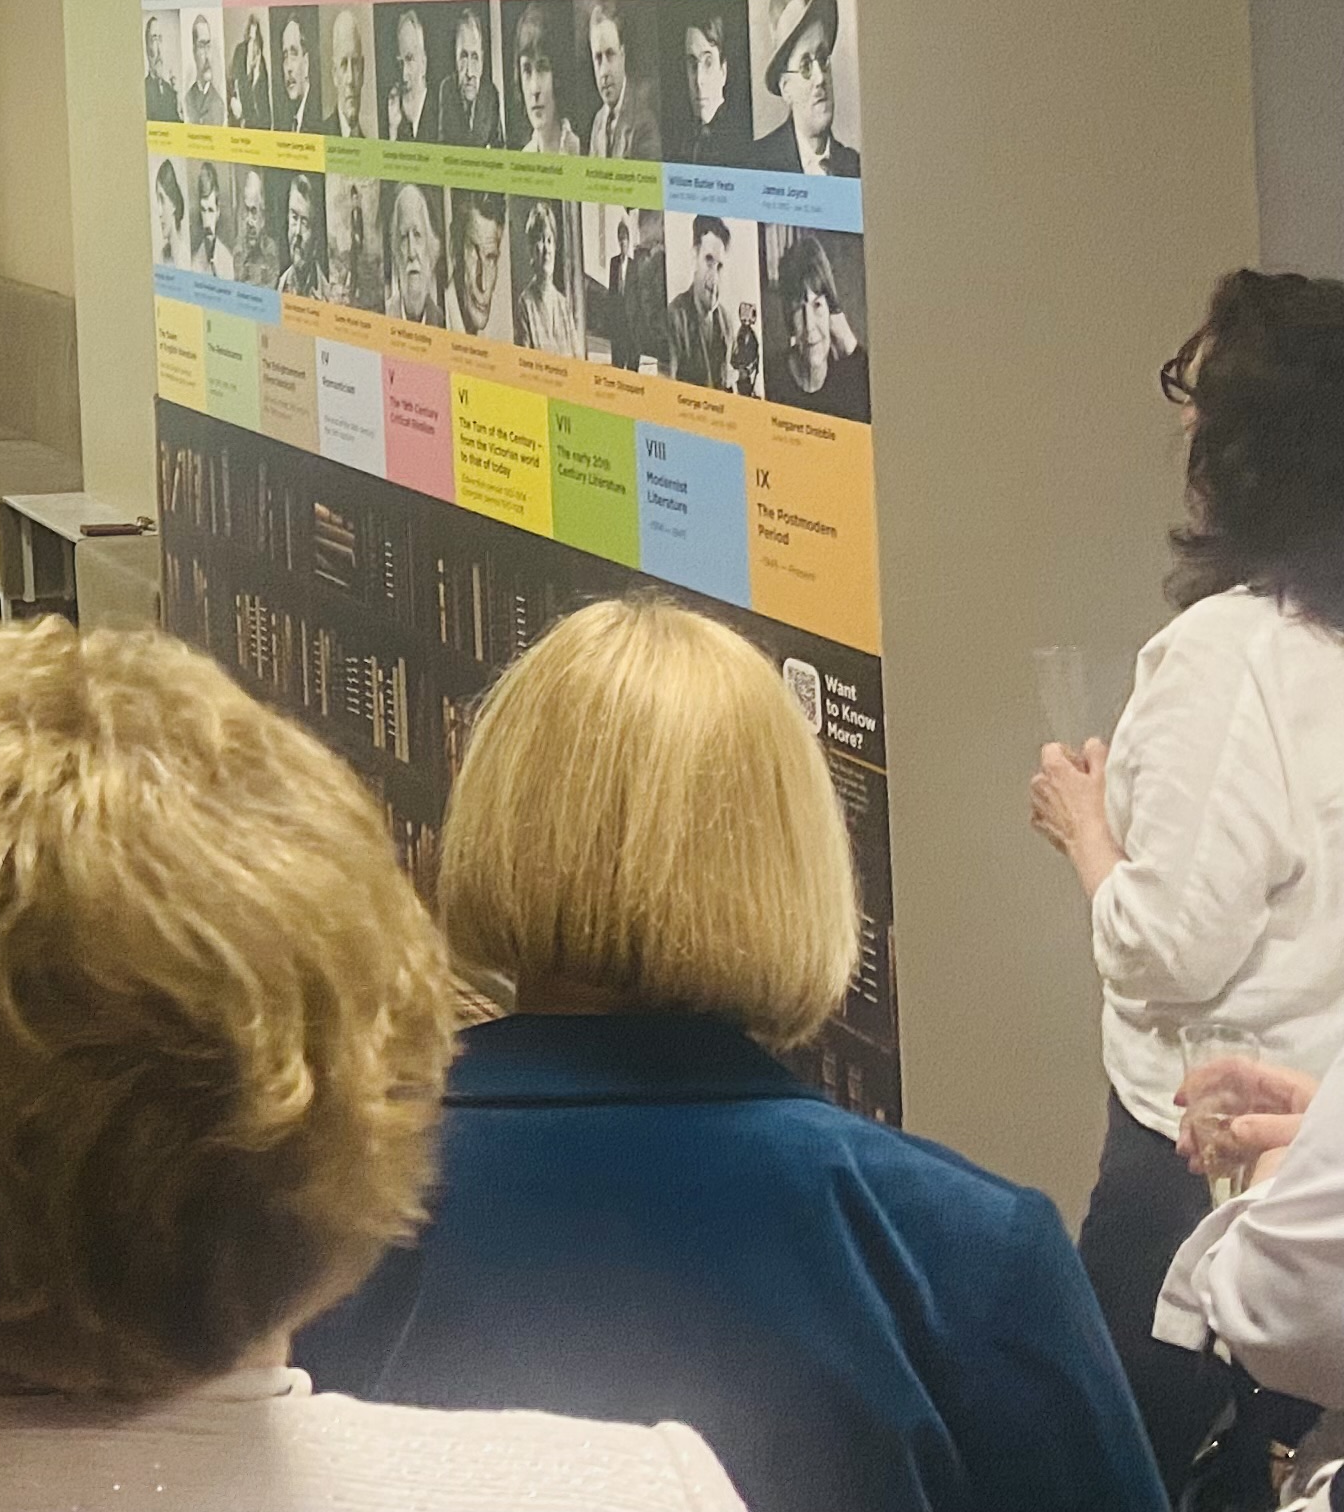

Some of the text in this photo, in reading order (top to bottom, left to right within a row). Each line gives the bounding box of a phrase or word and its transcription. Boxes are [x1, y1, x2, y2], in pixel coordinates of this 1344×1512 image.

[786, 187, 809, 199] Joyce
[388, 368, 395, 385] V
[458, 388, 468, 406] VI
[459, 417, 471, 430] The
[473, 420, 488, 434] Turn
[489, 426, 496, 436] of
[497, 427, 507, 439] the
[509, 431, 537, 451] Century
[556, 413, 571, 435] VII
[771, 416, 804, 434] Margaret
[460, 433, 540, 468] from the Victorian world
[557, 445, 570, 460] The
[572, 450, 590, 468] early
[646, 438, 667, 461] VIII
[460, 452, 512, 479] to that of today
[557, 463, 587, 486] Century
[646, 471, 688, 495] Modernist
[755, 468, 771, 490] IX
[647, 491, 688, 515] Literature
[757, 502, 838, 538] The Postmodern
[758, 524, 790, 546] Period
[824, 674, 857, 702] Want
[826, 698, 877, 732] to Know
[827, 721, 863, 750] More?
